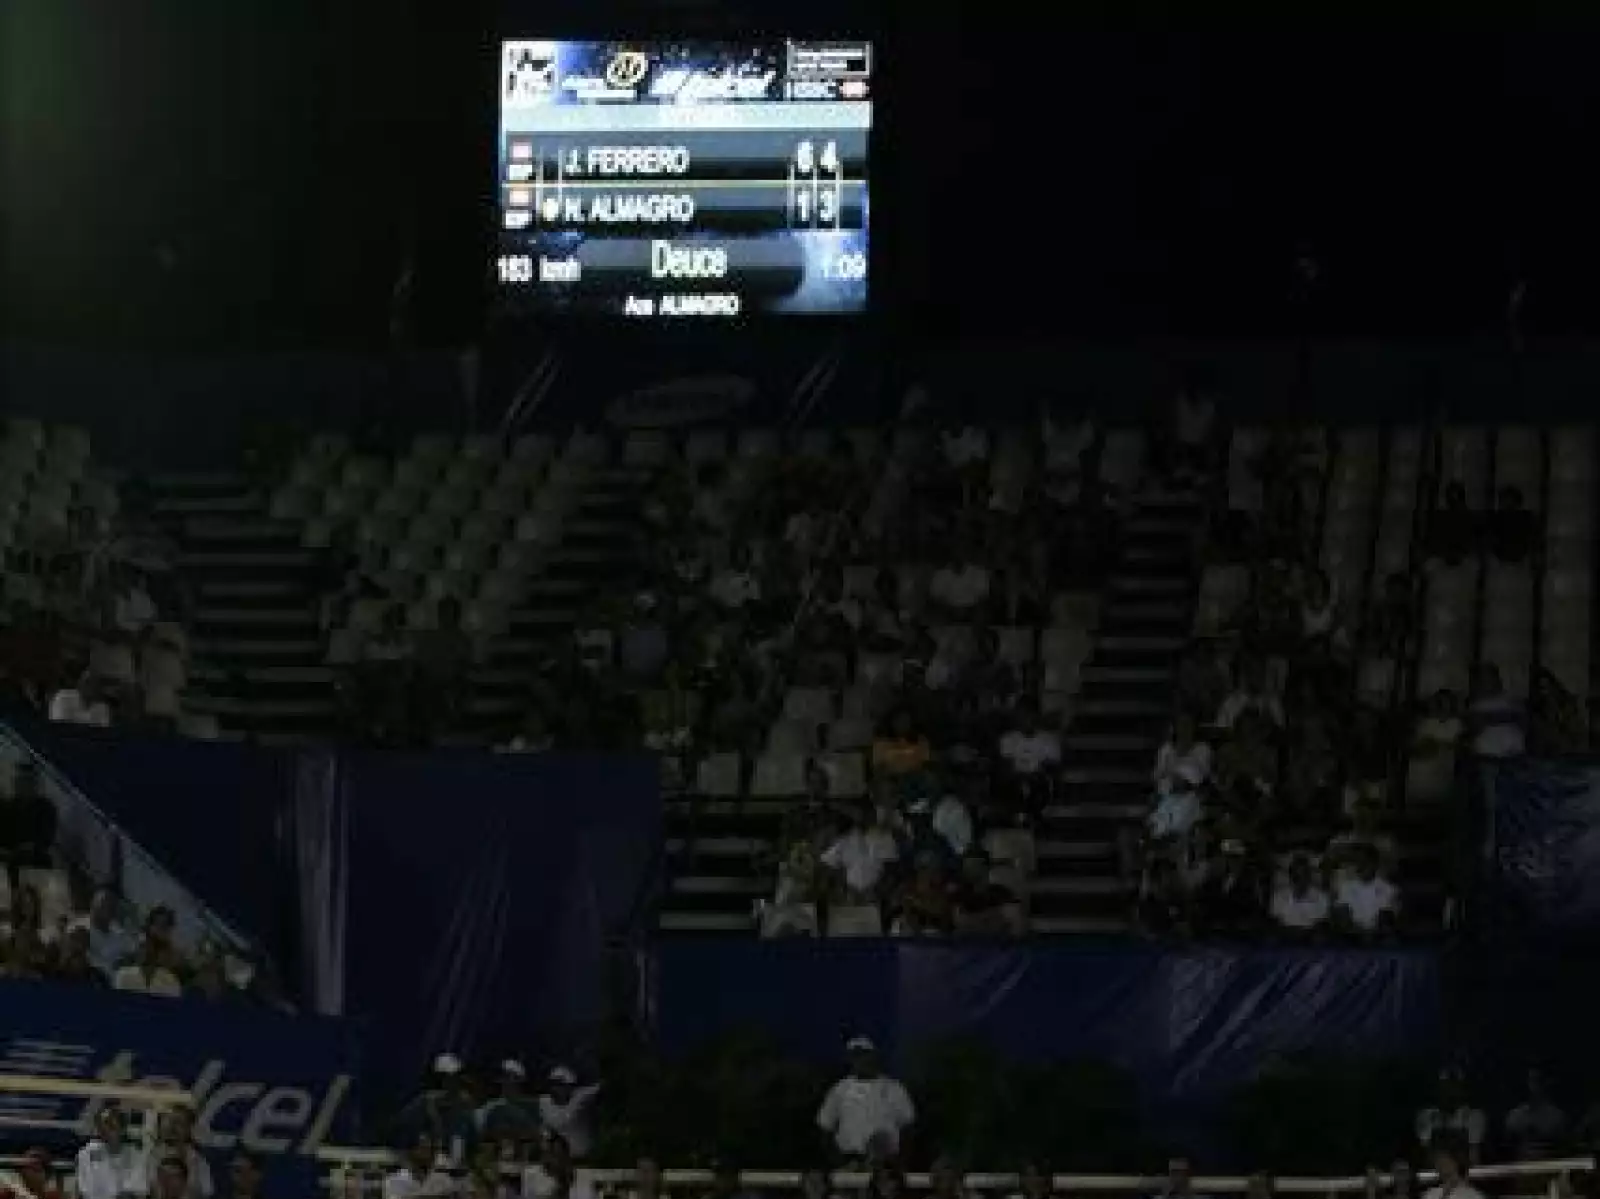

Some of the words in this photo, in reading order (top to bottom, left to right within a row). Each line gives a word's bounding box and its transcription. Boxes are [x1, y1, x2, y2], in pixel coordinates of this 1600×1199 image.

[587, 145, 690, 174] FERRERO
[796, 140, 814, 173] 6
[819, 140, 838, 173] 4
[591, 194, 694, 222] ALMAGRO
[797, 189, 811, 222] 1
[819, 189, 836, 222] 3
[651, 238, 728, 279] Deuce
[659, 292, 740, 316] ALMAGRO
